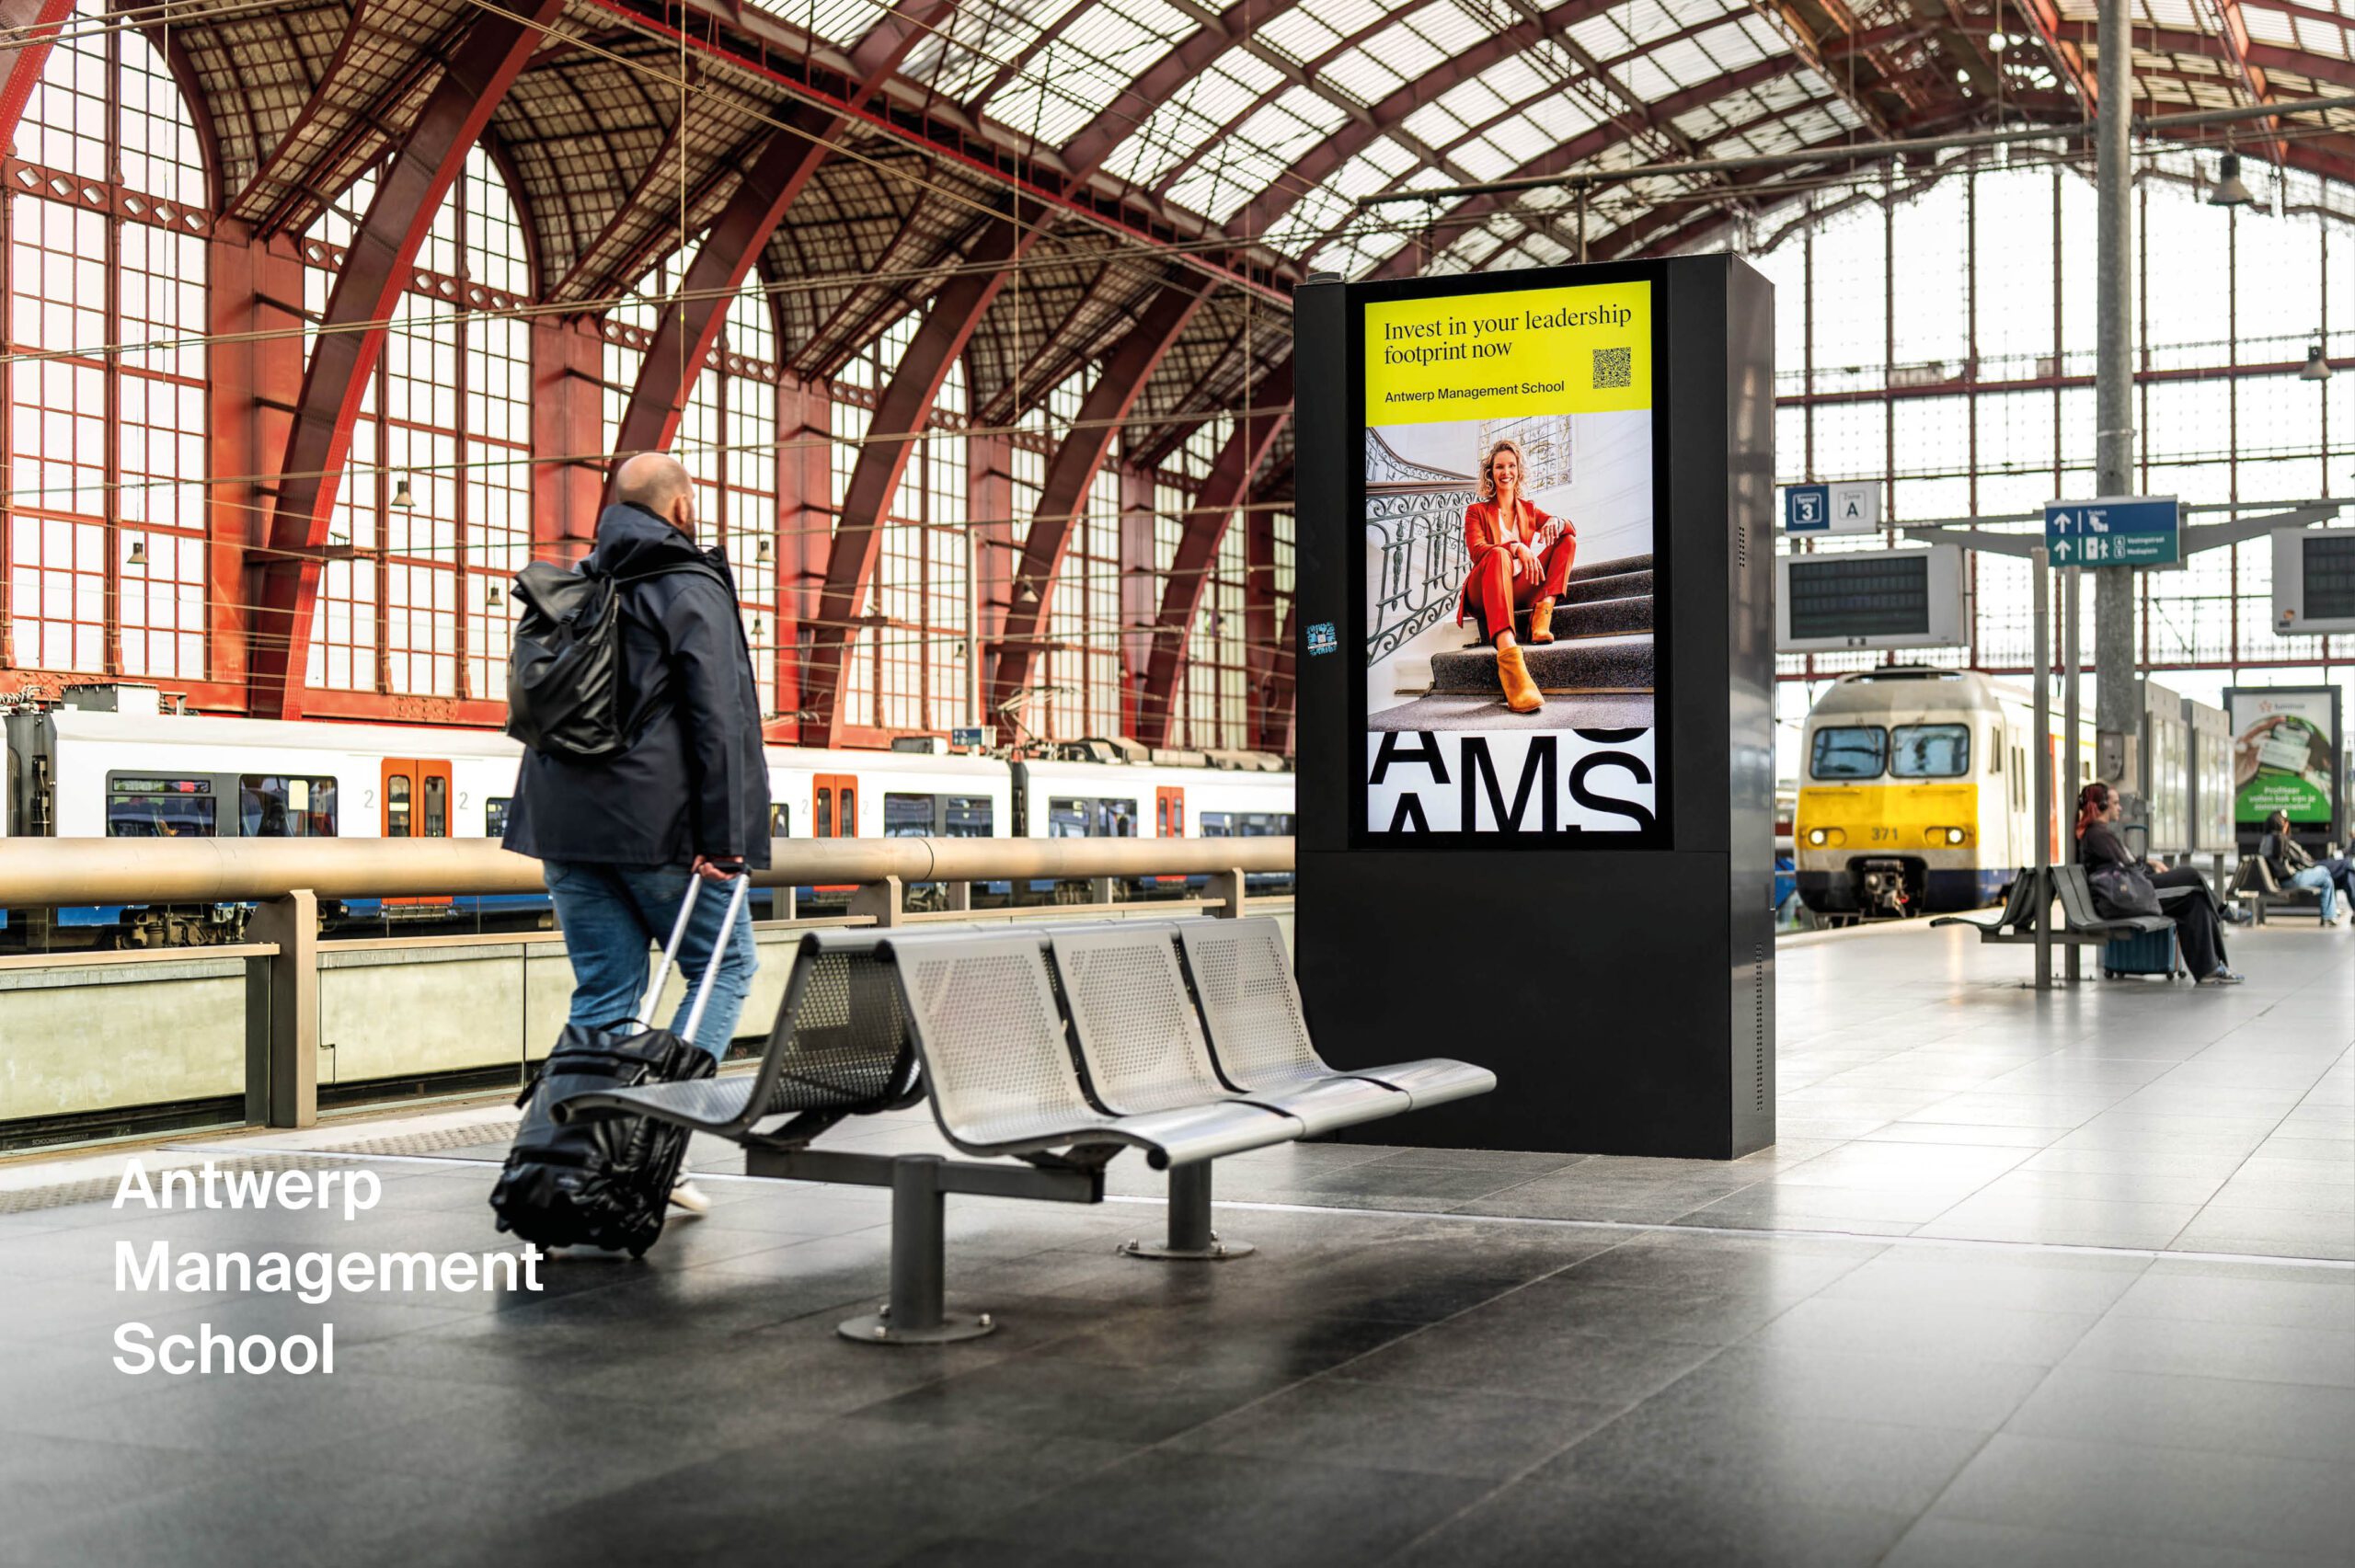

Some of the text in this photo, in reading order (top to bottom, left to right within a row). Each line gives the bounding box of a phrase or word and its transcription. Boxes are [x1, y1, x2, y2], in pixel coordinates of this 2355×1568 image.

[1384, 303, 1632, 340] Invest in your leadership
[1384, 340, 1512, 366] footprint now
[1384, 381, 1564, 403] Antwerp Management School
[1802, 504, 1813, 521] 3
[1846, 501, 1858, 518] A
[364, 789, 374, 808] 2
[459, 792, 468, 810] 2
[802, 799, 809, 815] 2
[1871, 826, 1899, 841] 371
